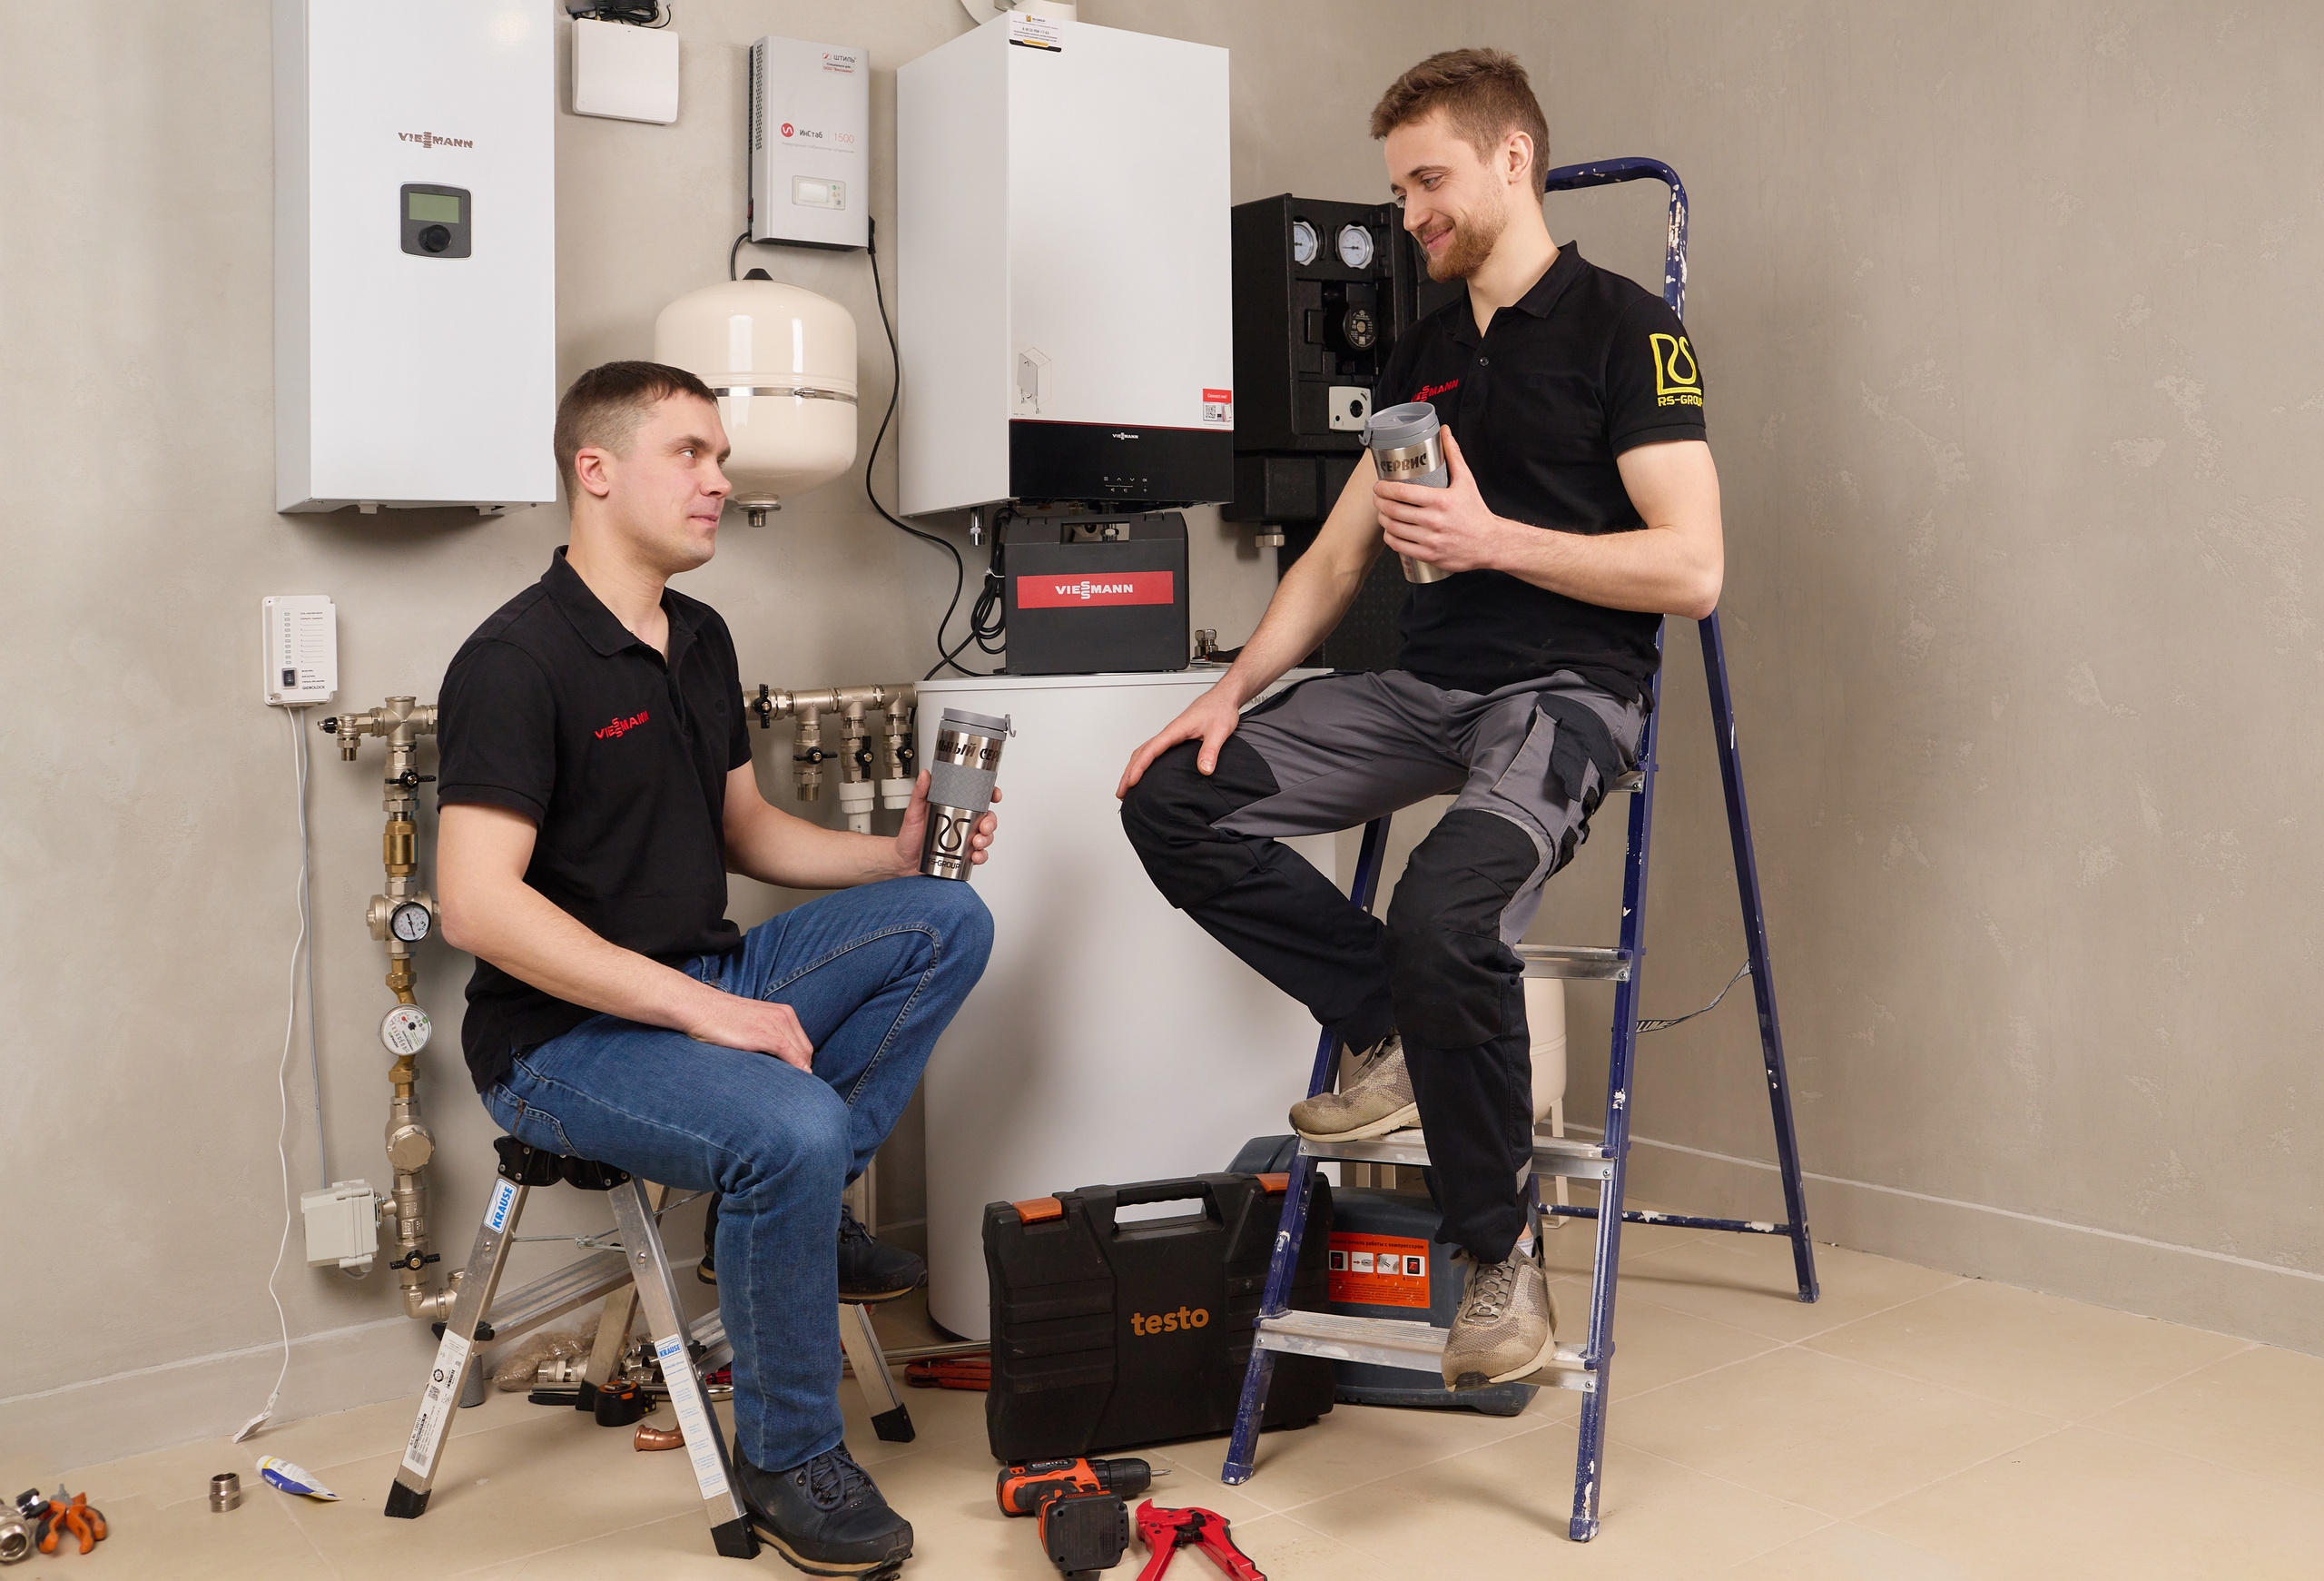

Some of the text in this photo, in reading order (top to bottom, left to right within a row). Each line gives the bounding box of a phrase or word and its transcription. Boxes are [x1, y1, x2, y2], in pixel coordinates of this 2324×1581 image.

[832, 54, 855, 64] ШТИЛЬ
[799, 129, 854, 143] ИнСтаб 1500
[1380, 452, 1427, 473] СЕРВИС
[1055, 581, 1133, 599] VIESSMANN
[595, 710, 650, 740] VIESSMANN
[492, 1186, 513, 1228] KRAUSE
[1130, 1306, 1209, 1336] testo
[659, 1343, 681, 1359] KRAUSE
